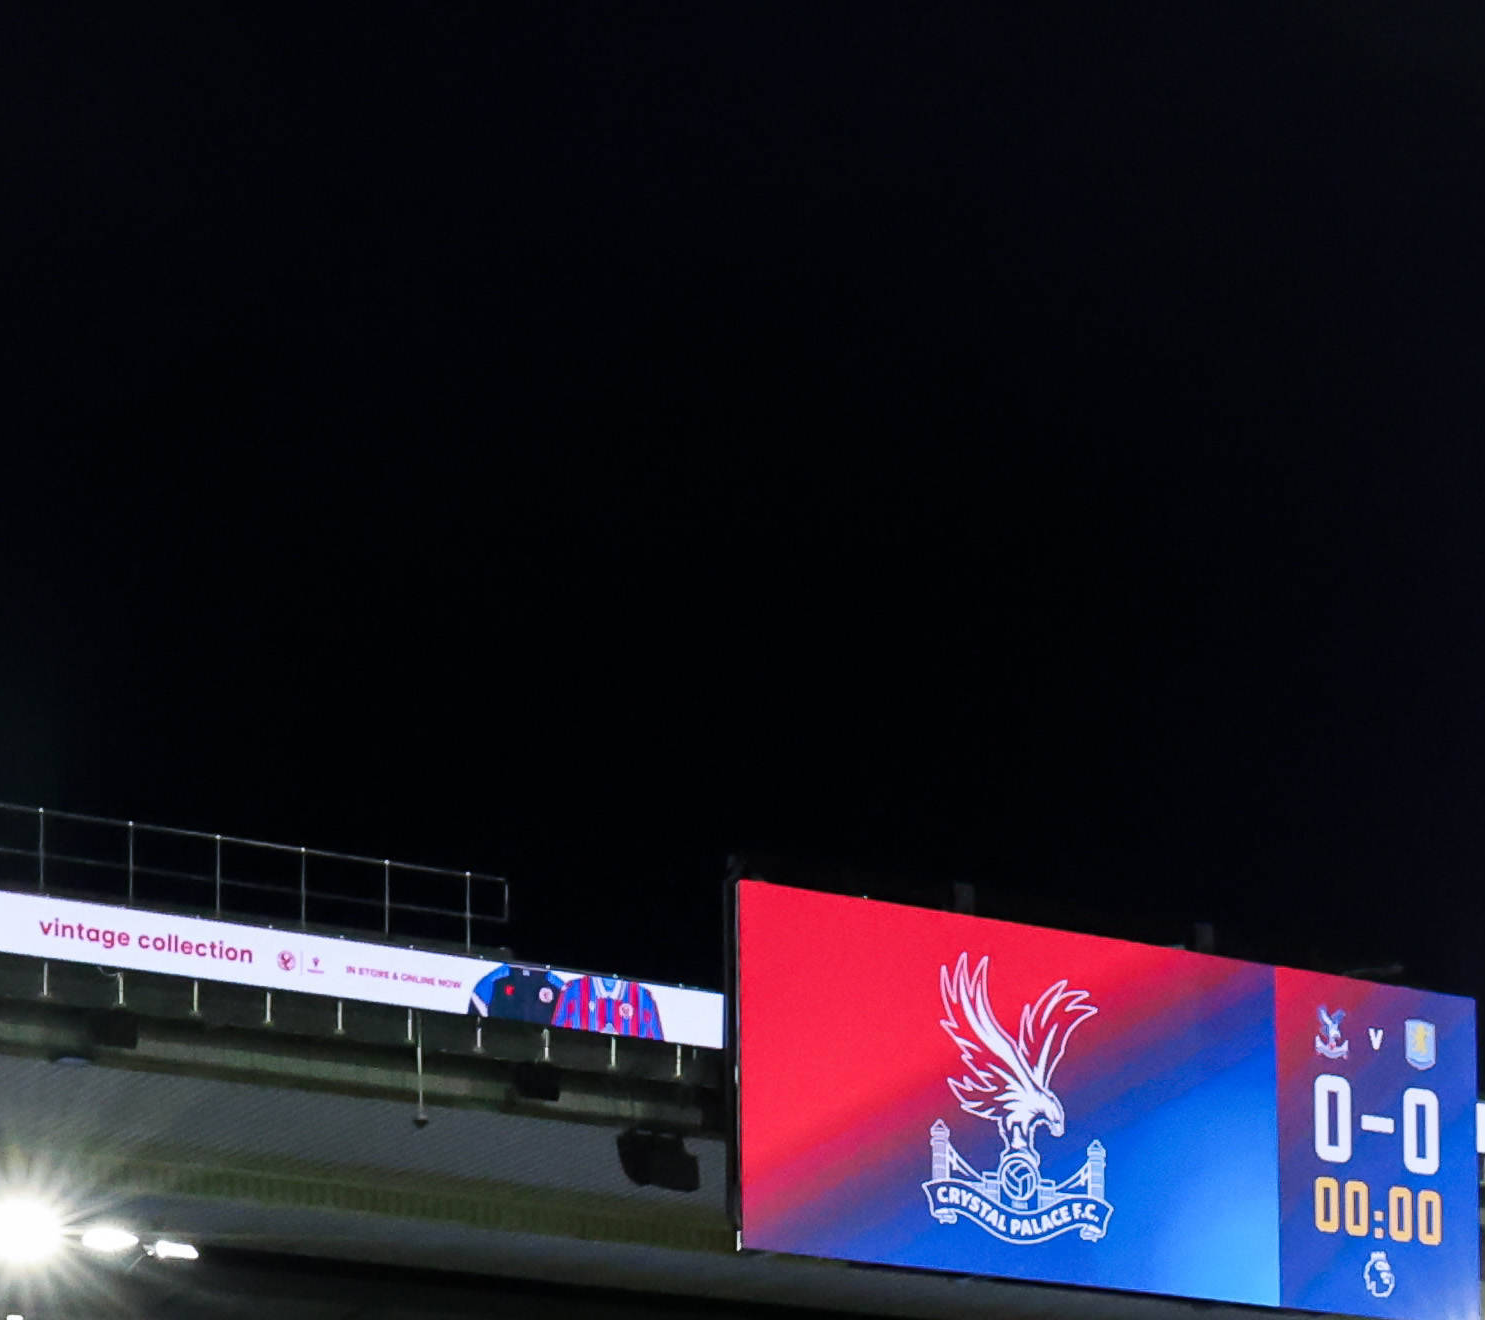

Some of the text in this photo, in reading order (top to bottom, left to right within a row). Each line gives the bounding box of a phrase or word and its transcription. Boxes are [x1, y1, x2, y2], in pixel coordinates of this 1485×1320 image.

[38, 916, 253, 964] vintage collection
[936, 1186, 1101, 1237] CRYSTAL PALACE F.C.
[1314, 1175, 1443, 1247] 00:00
